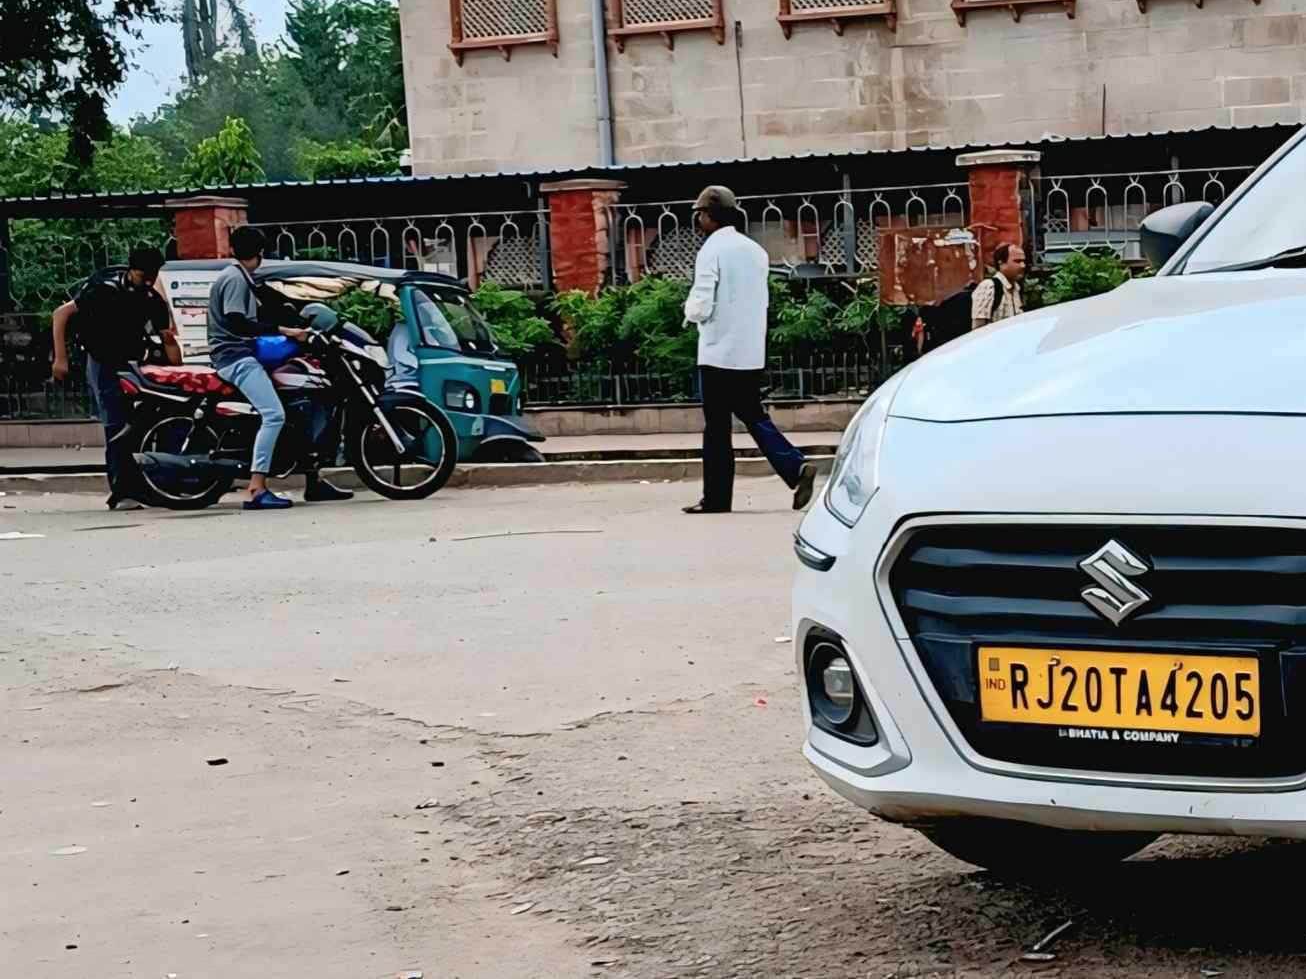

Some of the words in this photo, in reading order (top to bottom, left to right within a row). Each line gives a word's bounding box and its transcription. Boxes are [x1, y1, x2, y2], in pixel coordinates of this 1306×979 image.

[985, 678, 1006, 691] IND
[1009, 660, 1254, 721] RJ20TA4205
[1068, 728, 1109, 740] BHATIA
[1123, 731, 1179, 743] COMPANY
